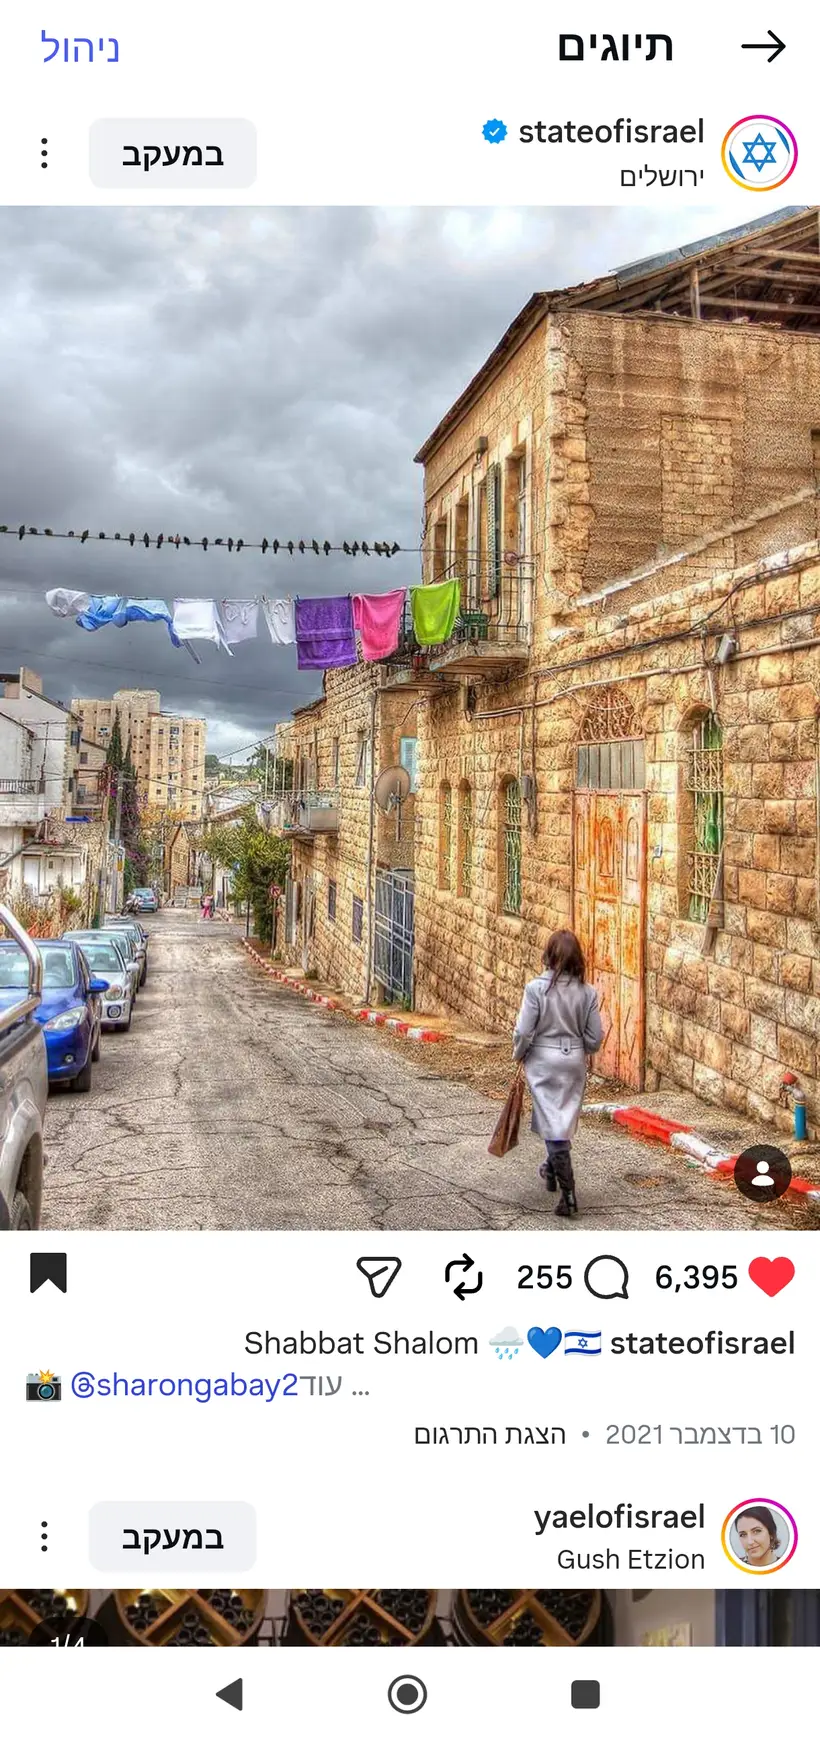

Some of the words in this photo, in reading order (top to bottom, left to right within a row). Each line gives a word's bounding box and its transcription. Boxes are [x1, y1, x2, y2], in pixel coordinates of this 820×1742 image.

[40, 29, 119, 63] ניהול
[558, 33, 673, 62] תיוגים
[519, 117, 704, 144] stateofisrael
[122, 145, 225, 172] במעקב
[620, 163, 704, 188] ירושלים
[517, 1264, 573, 1290] 255
[655, 1264, 738, 1294] 6,395
[244, 1329, 365, 1355] Shabbat
[373, 1330, 478, 1355] Shalom
[610, 1329, 795, 1355] stateofisrael
[414, 1426, 497, 1445] התרגום
[504, 1426, 566, 1445] הצגת
[605, 1424, 662, 1445] 2021
[669, 1425, 763, 1445] בדצמבר
[769, 1424, 796, 1445] 10
[533, 1502, 705, 1536] yaelofisrael
[122, 1528, 225, 1556] במעקב
[557, 1547, 620, 1570] Gush
[628, 1547, 705, 1570] Etzion
